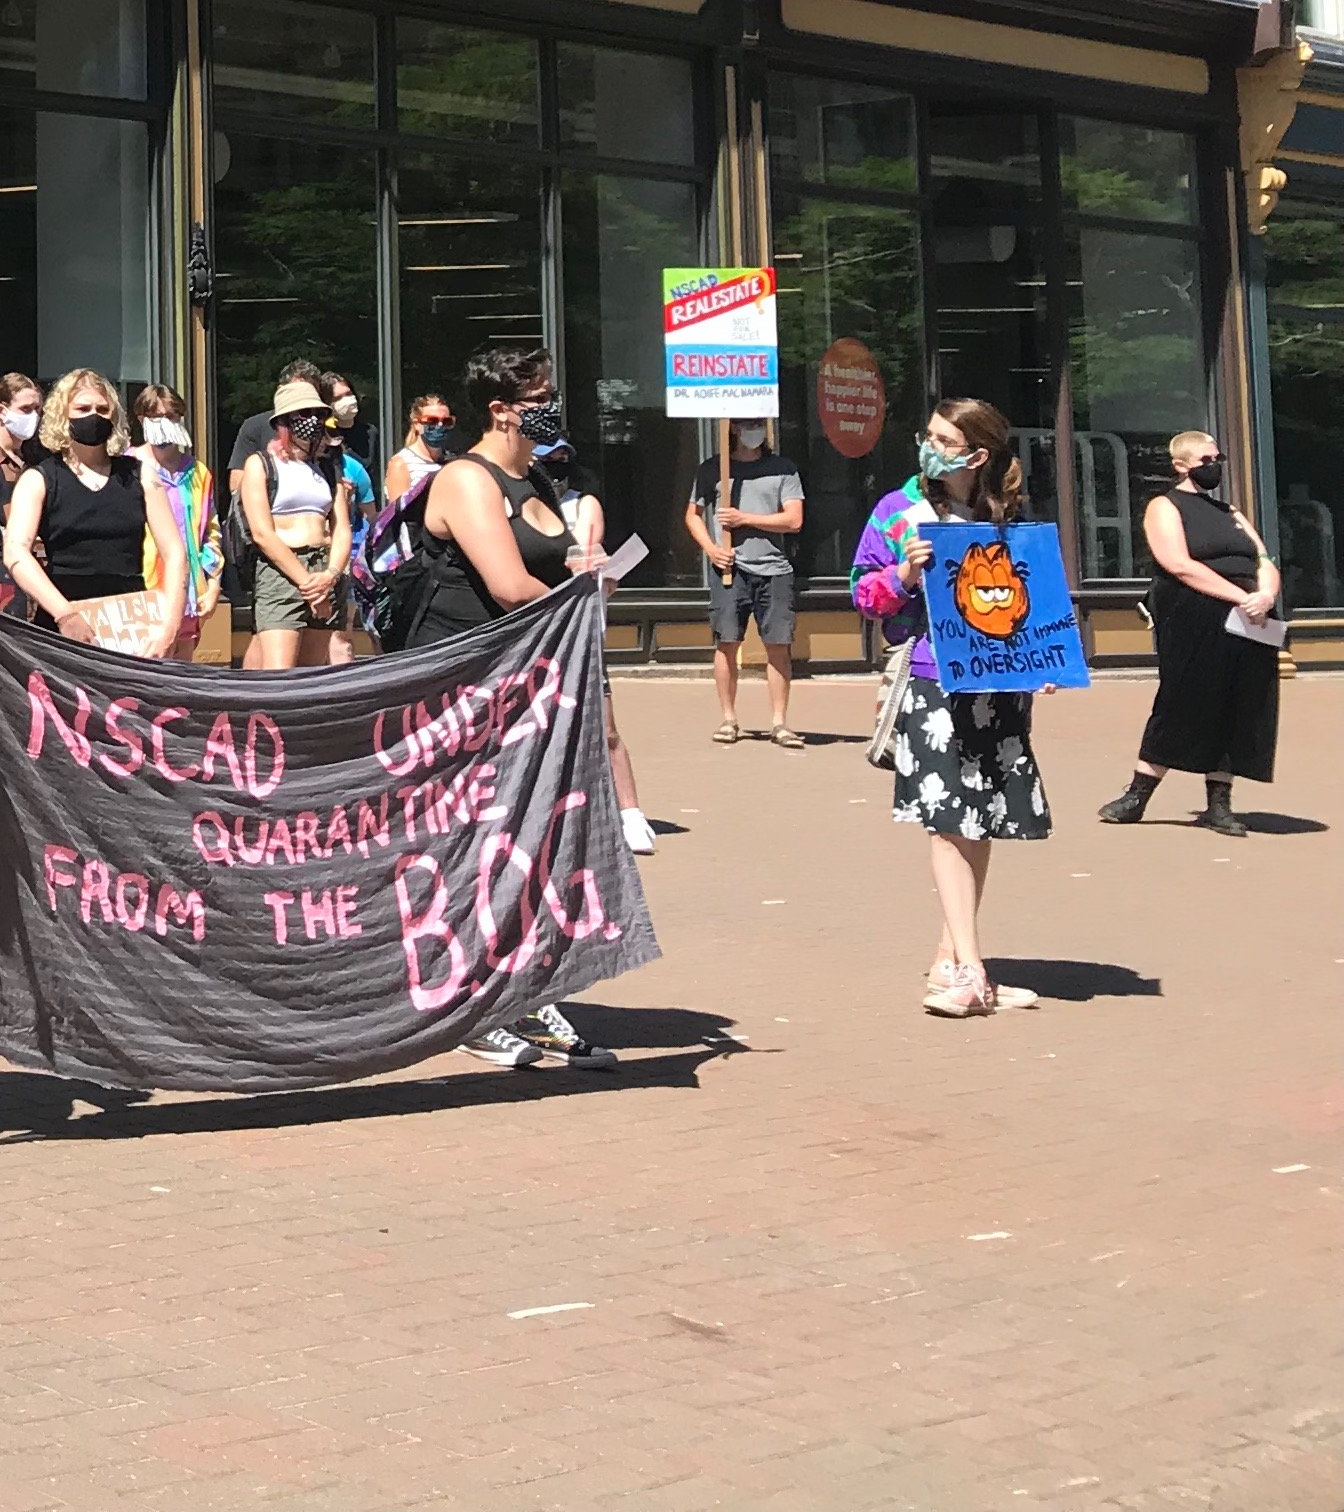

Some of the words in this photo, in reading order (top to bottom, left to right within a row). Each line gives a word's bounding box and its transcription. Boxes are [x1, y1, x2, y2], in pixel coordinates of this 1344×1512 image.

[670, 274, 718, 299] NSCAD
[673, 354, 769, 377] REINSTATE
[934, 619, 966, 641] YOU
[969, 636, 999, 653] ARE
[1004, 627, 1031, 653] NOT
[948, 659, 966, 681] TO
[970, 644, 1066, 678] OVERSIGHT
[26, 670, 285, 798] NSCAD
[372, 657, 576, 777] UNDER
[192, 763, 508, 867] QUARANTINE
[43, 844, 206, 942] FROM
[263, 888, 363, 945] THE
